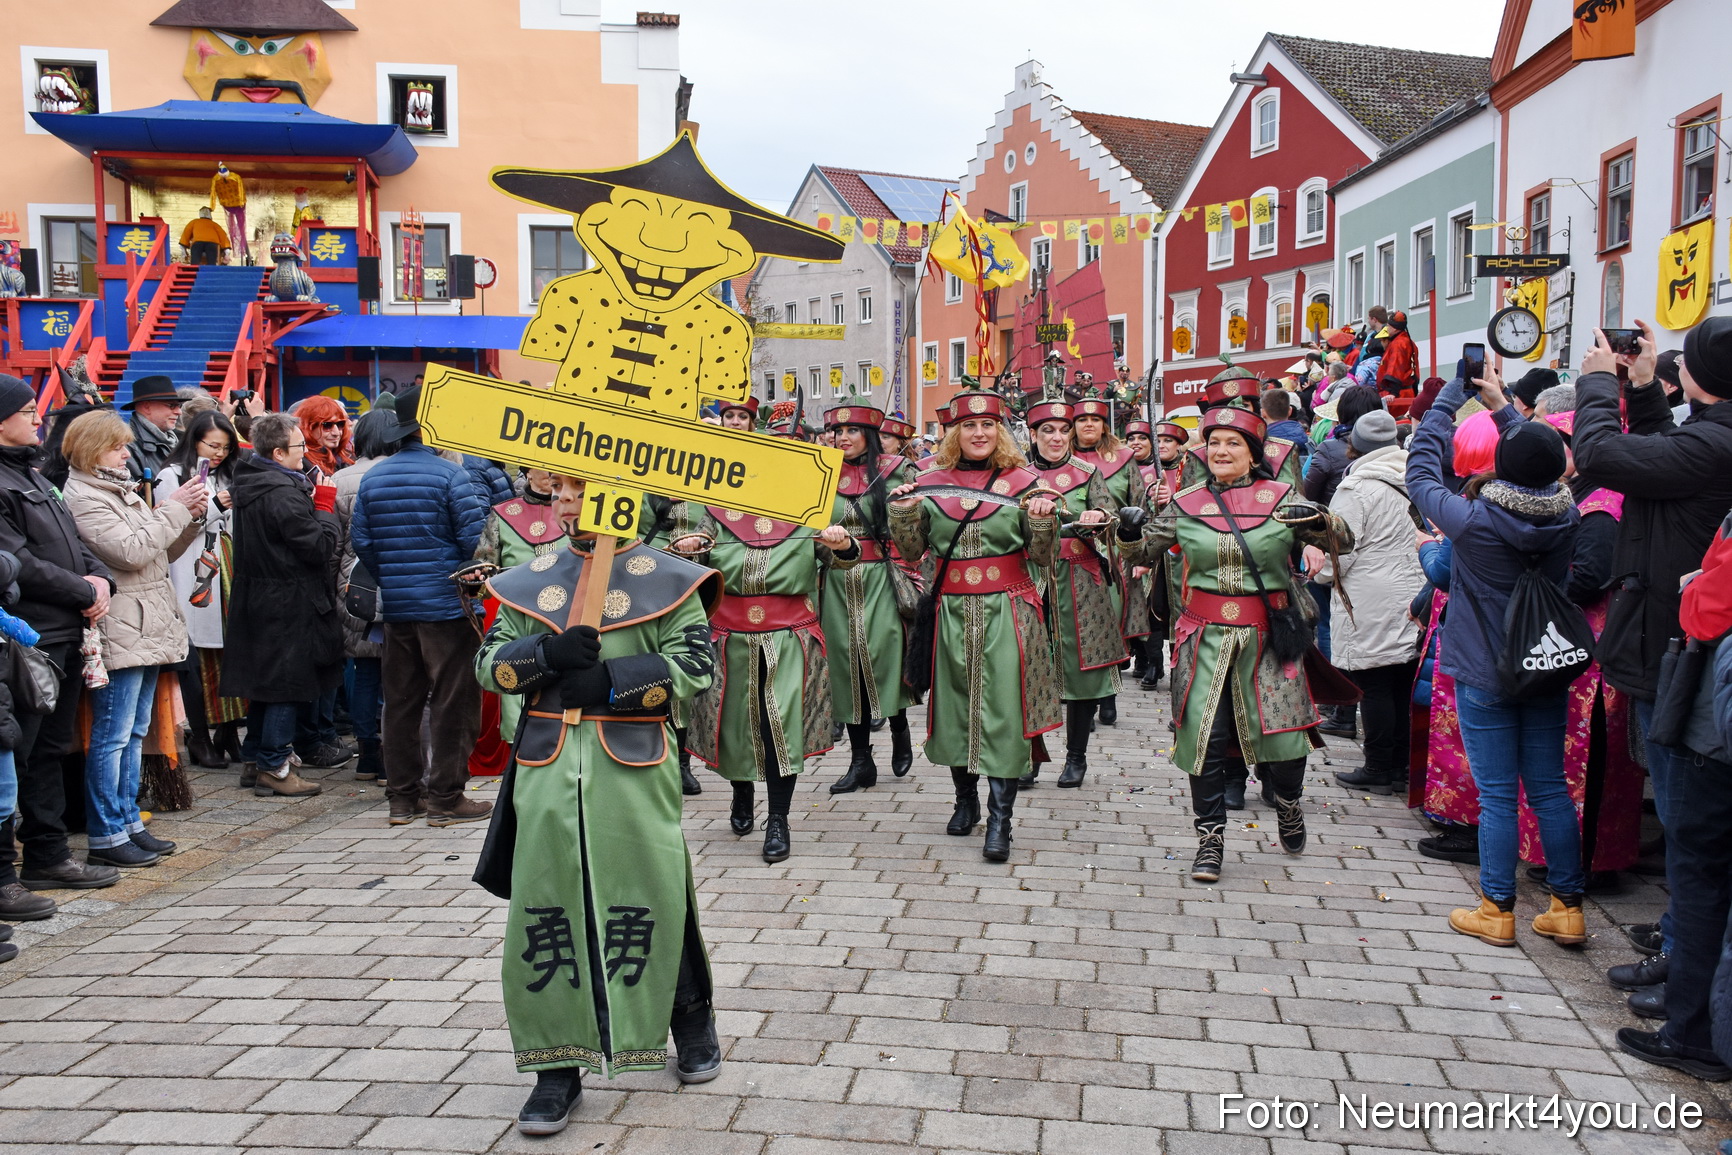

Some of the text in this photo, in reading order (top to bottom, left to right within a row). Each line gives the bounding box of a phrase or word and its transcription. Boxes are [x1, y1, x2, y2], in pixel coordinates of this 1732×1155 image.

[1486, 258, 1560, 268] RÖHLICH
[1037, 324, 1067, 333] KAISER
[1040, 333, 1066, 343] 2020
[894, 350, 902, 410] SCHMUCK
[1173, 379, 1209, 395] GÖTZ
[499, 406, 747, 490] Drachengruppe
[588, 491, 636, 532] 18
[1522, 648, 1589, 671] adidas
